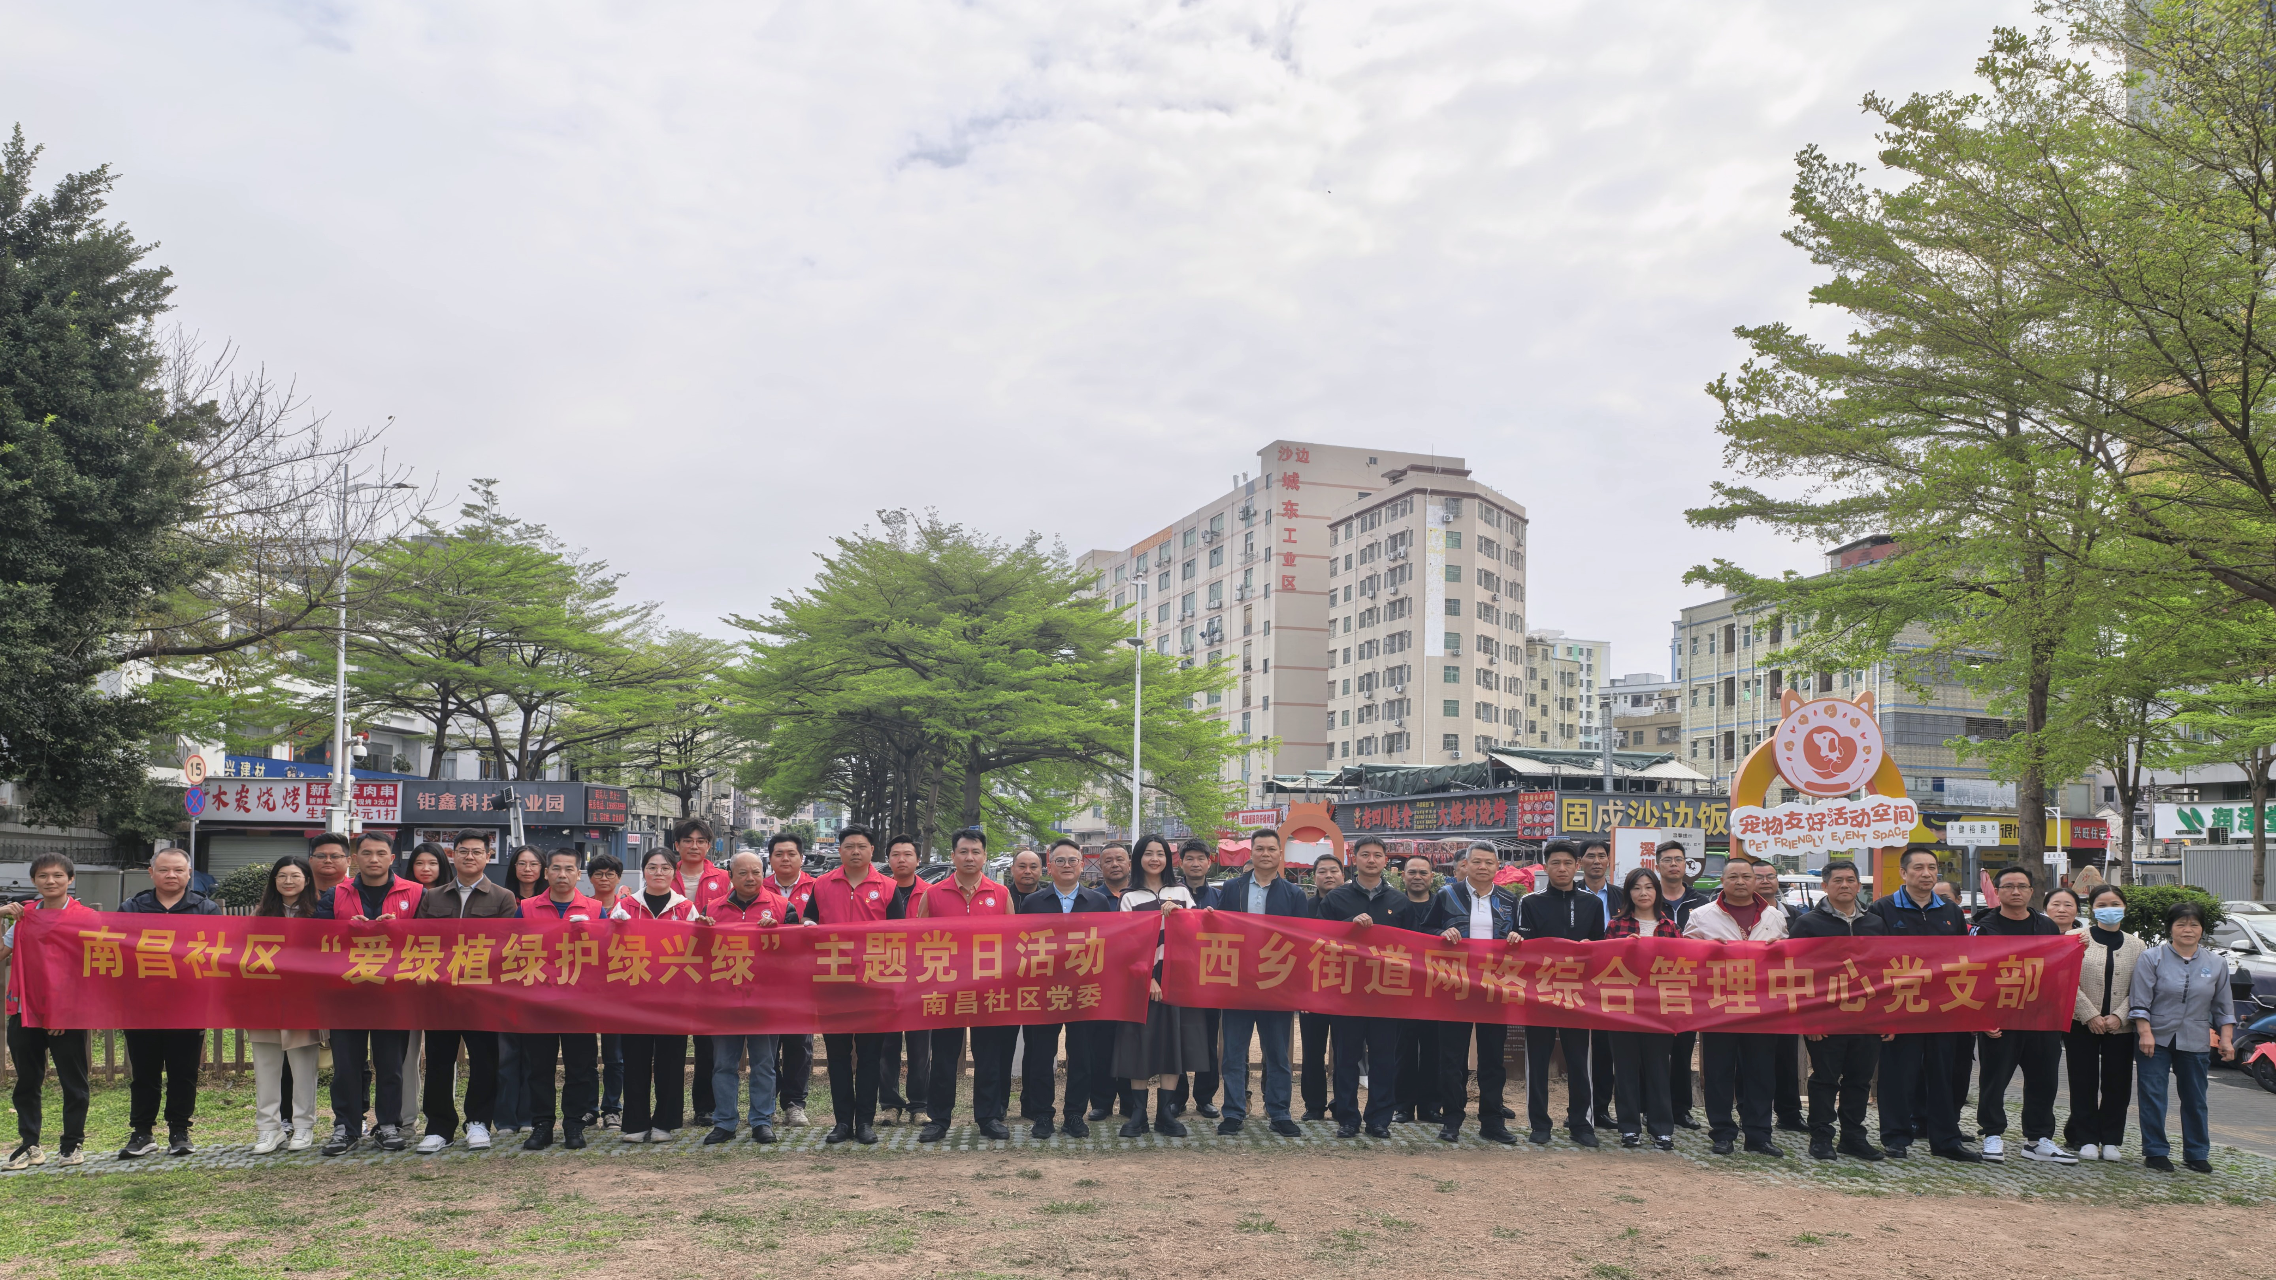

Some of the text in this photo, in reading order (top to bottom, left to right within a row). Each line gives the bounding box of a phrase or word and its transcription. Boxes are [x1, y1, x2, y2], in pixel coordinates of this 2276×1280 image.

[1278, 446, 1310, 463] 沙边
[1281, 472, 1300, 590] 城东工业区
[190, 762, 202, 776] 15
[211, 784, 301, 814] 木炭烧烤
[310, 784, 395, 797] 新羊肉串
[417, 792, 564, 813] 钜鑫科业园
[1362, 802, 1413, 829] 老四川美食
[1738, 803, 1915, 836] 宠物友好活动空间
[1748, 827, 1909, 852] PET FRIENDLY EVENT SPACE
[78, 925, 1106, 986] 南昌社区 “爱绿植绿护绿兴绿” 主题党日活动
[1196, 931, 2046, 1015] 西乡街道网格综合管理中心党支部
[921, 982, 1102, 1017] 南昌社区党委
